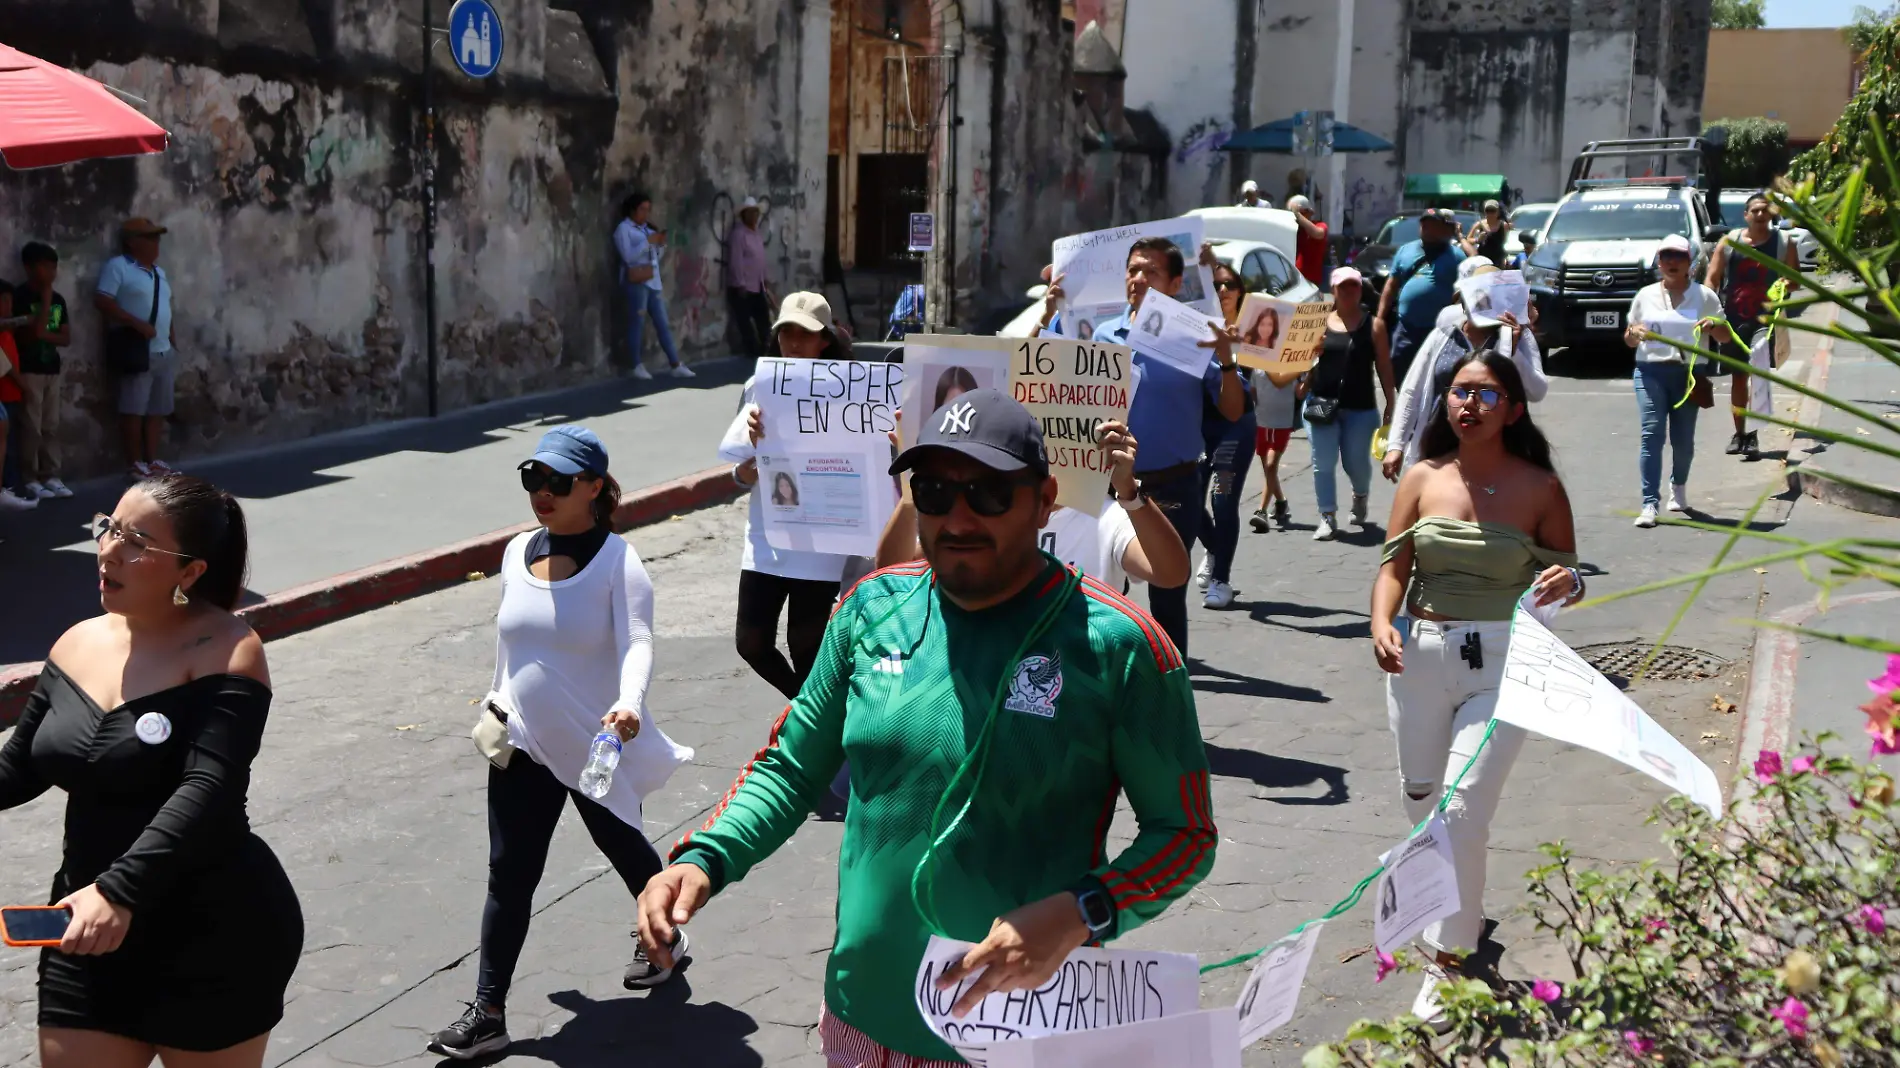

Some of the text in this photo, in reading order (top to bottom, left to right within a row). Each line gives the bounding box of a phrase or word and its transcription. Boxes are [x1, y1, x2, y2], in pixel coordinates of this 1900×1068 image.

[1590, 315, 1615, 325] 1865
[1018, 341, 1123, 381] 16 DÍAS
[763, 360, 796, 396] TE
[1014, 382, 1128, 409] DESAPARECIDA
[797, 399, 901, 434] EN CAS
[1031, 416, 1117, 445] UEREMO
